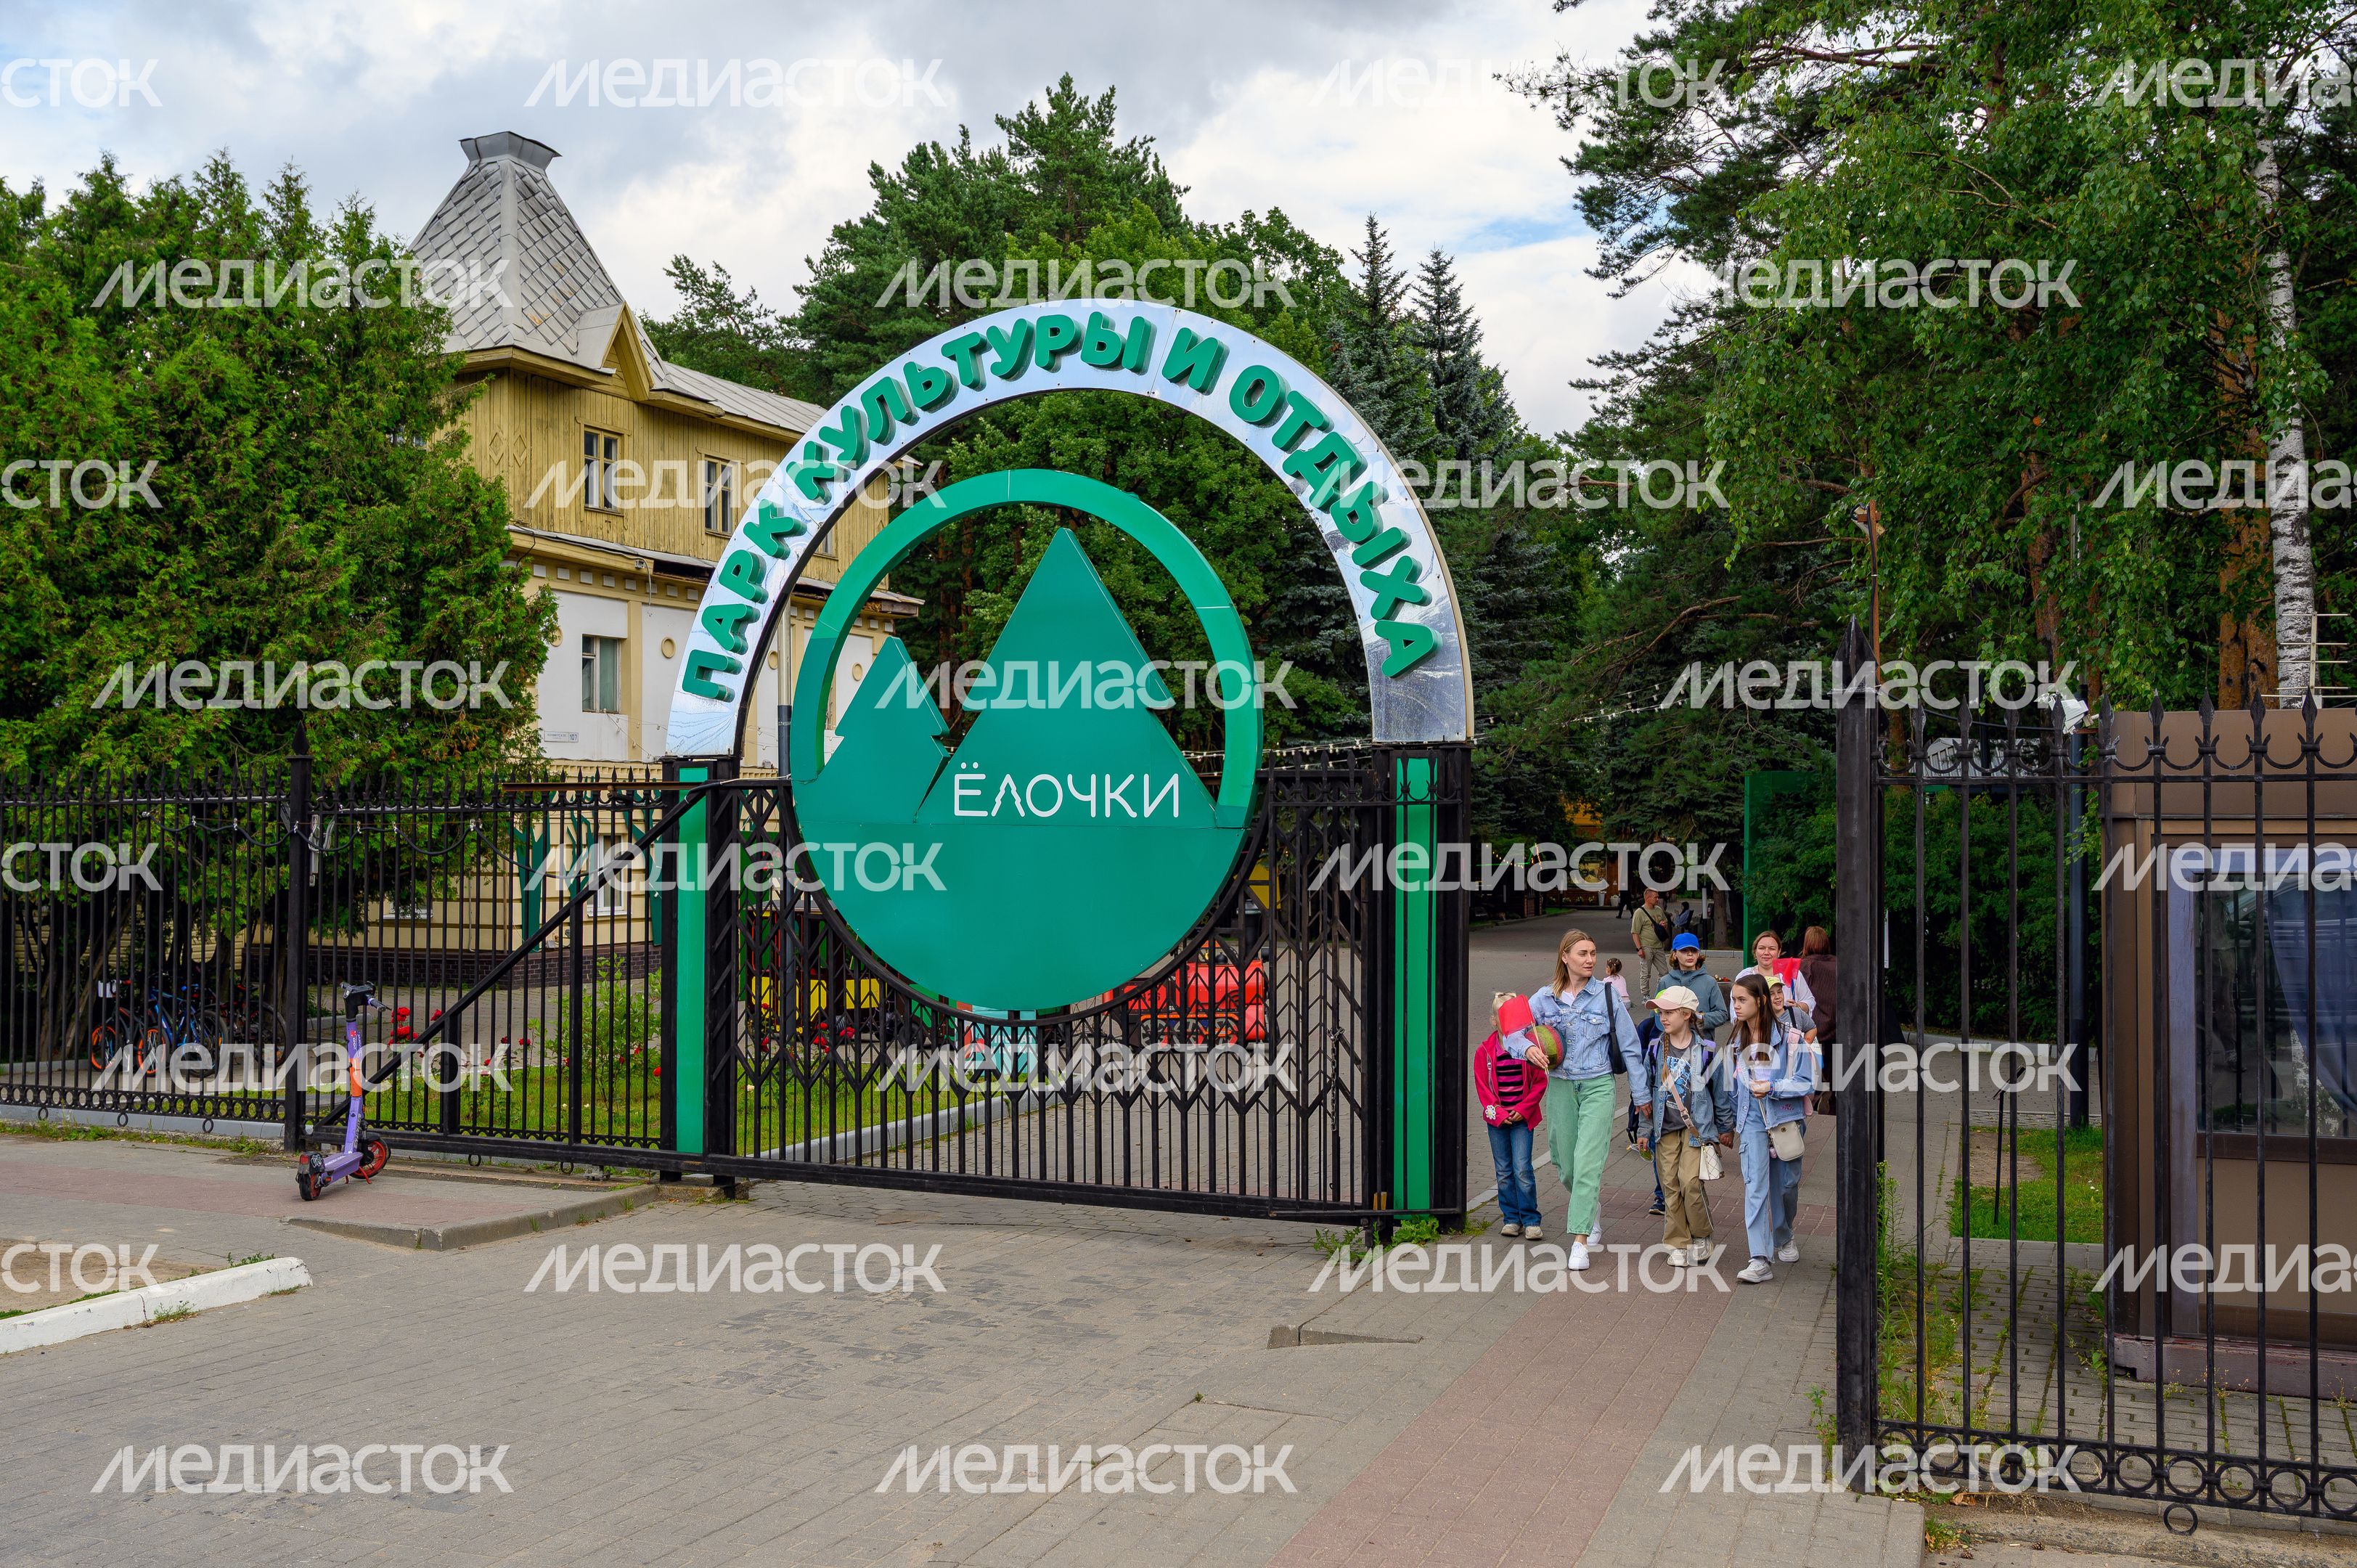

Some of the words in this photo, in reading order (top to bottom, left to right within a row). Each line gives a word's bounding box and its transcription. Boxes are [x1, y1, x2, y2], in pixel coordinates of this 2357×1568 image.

[682, 498, 807, 704] ПАРК
[785, 311, 1157, 505] КУЛЬТУРЫ
[1161, 327, 1230, 393] И
[1228, 364, 1444, 679] ОТДЫХА
[954, 761, 1180, 818] ЁЛОЧКИ
